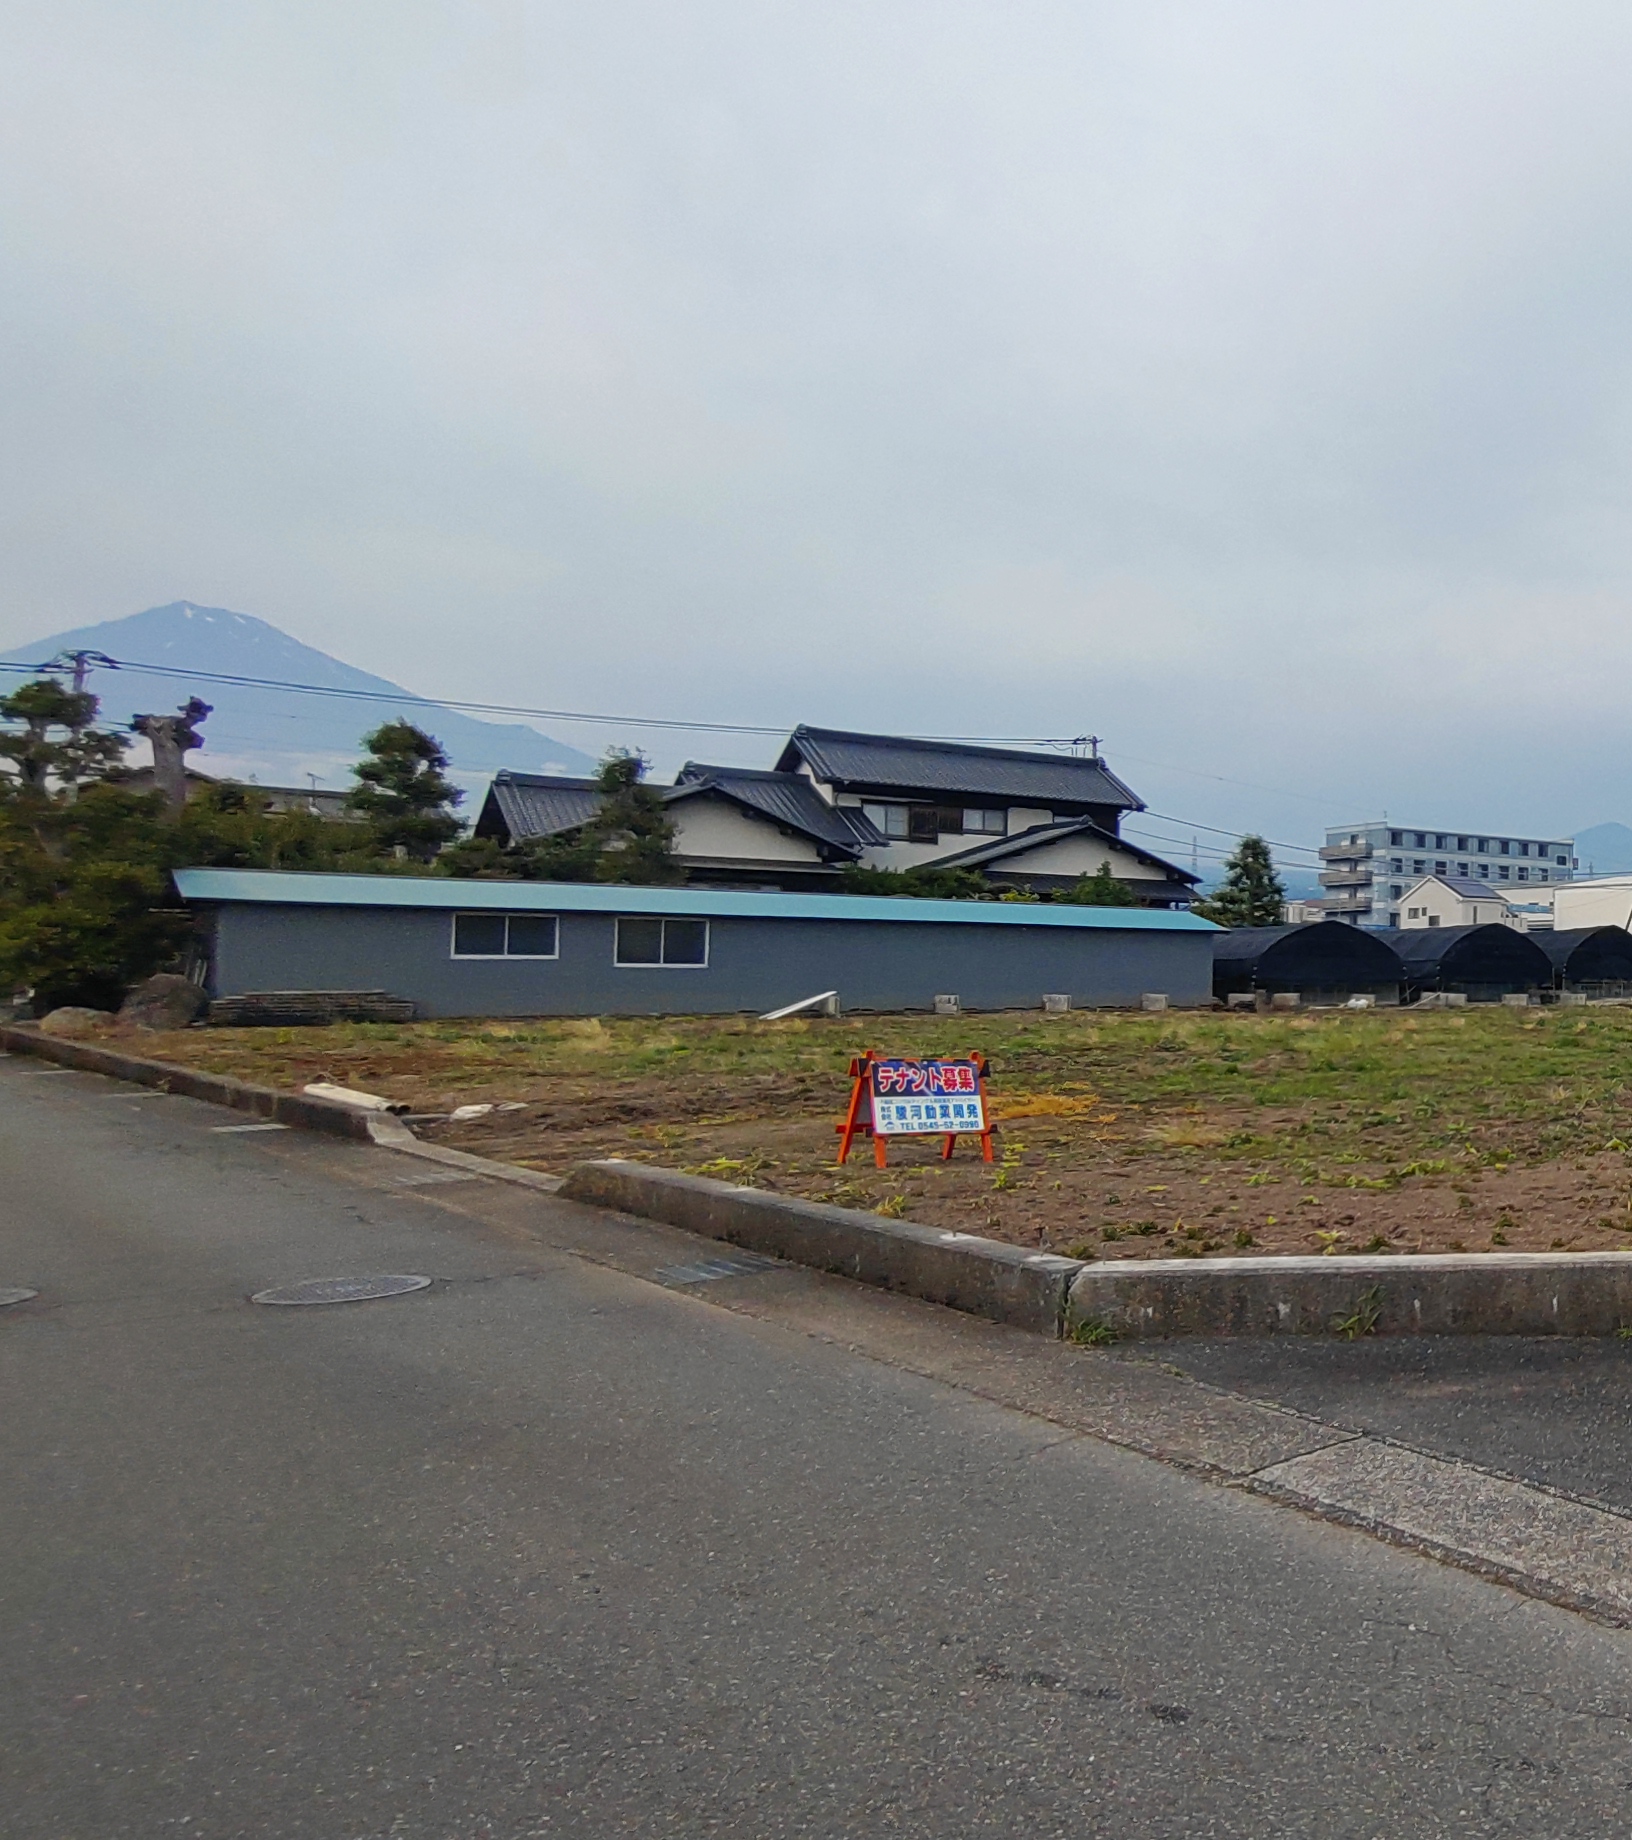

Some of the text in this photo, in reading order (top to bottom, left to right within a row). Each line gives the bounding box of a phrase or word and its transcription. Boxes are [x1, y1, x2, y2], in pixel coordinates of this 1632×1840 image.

[878, 1067, 975, 1092] テナント募集
[900, 1122, 916, 1131] TEL
